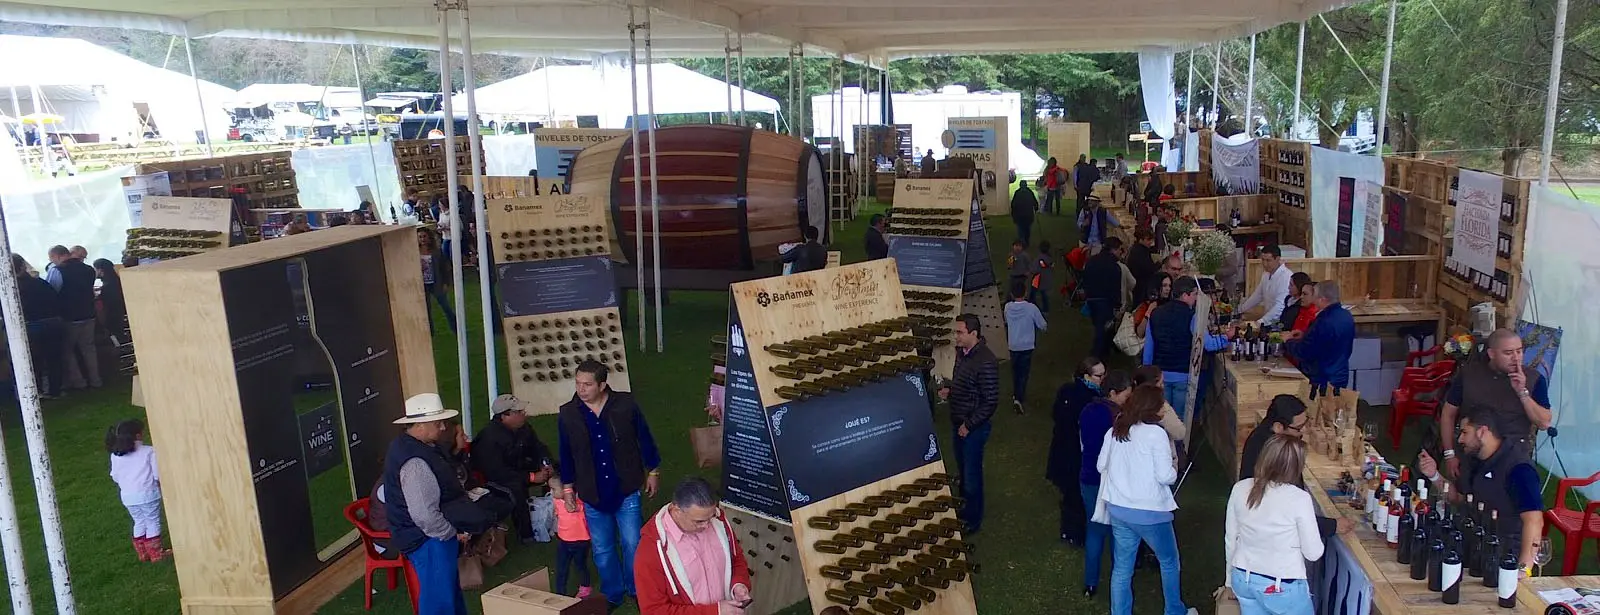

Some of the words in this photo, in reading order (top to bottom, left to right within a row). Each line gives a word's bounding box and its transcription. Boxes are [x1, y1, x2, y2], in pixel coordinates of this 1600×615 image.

[536, 134, 571, 142] NIVELES
[1461, 214, 1491, 239] FLORIDA
[773, 288, 815, 303] Banamex
[834, 302, 849, 312] WINE
[849, 298, 880, 309] EXPERIENCE
[307, 429, 334, 449] WINE
